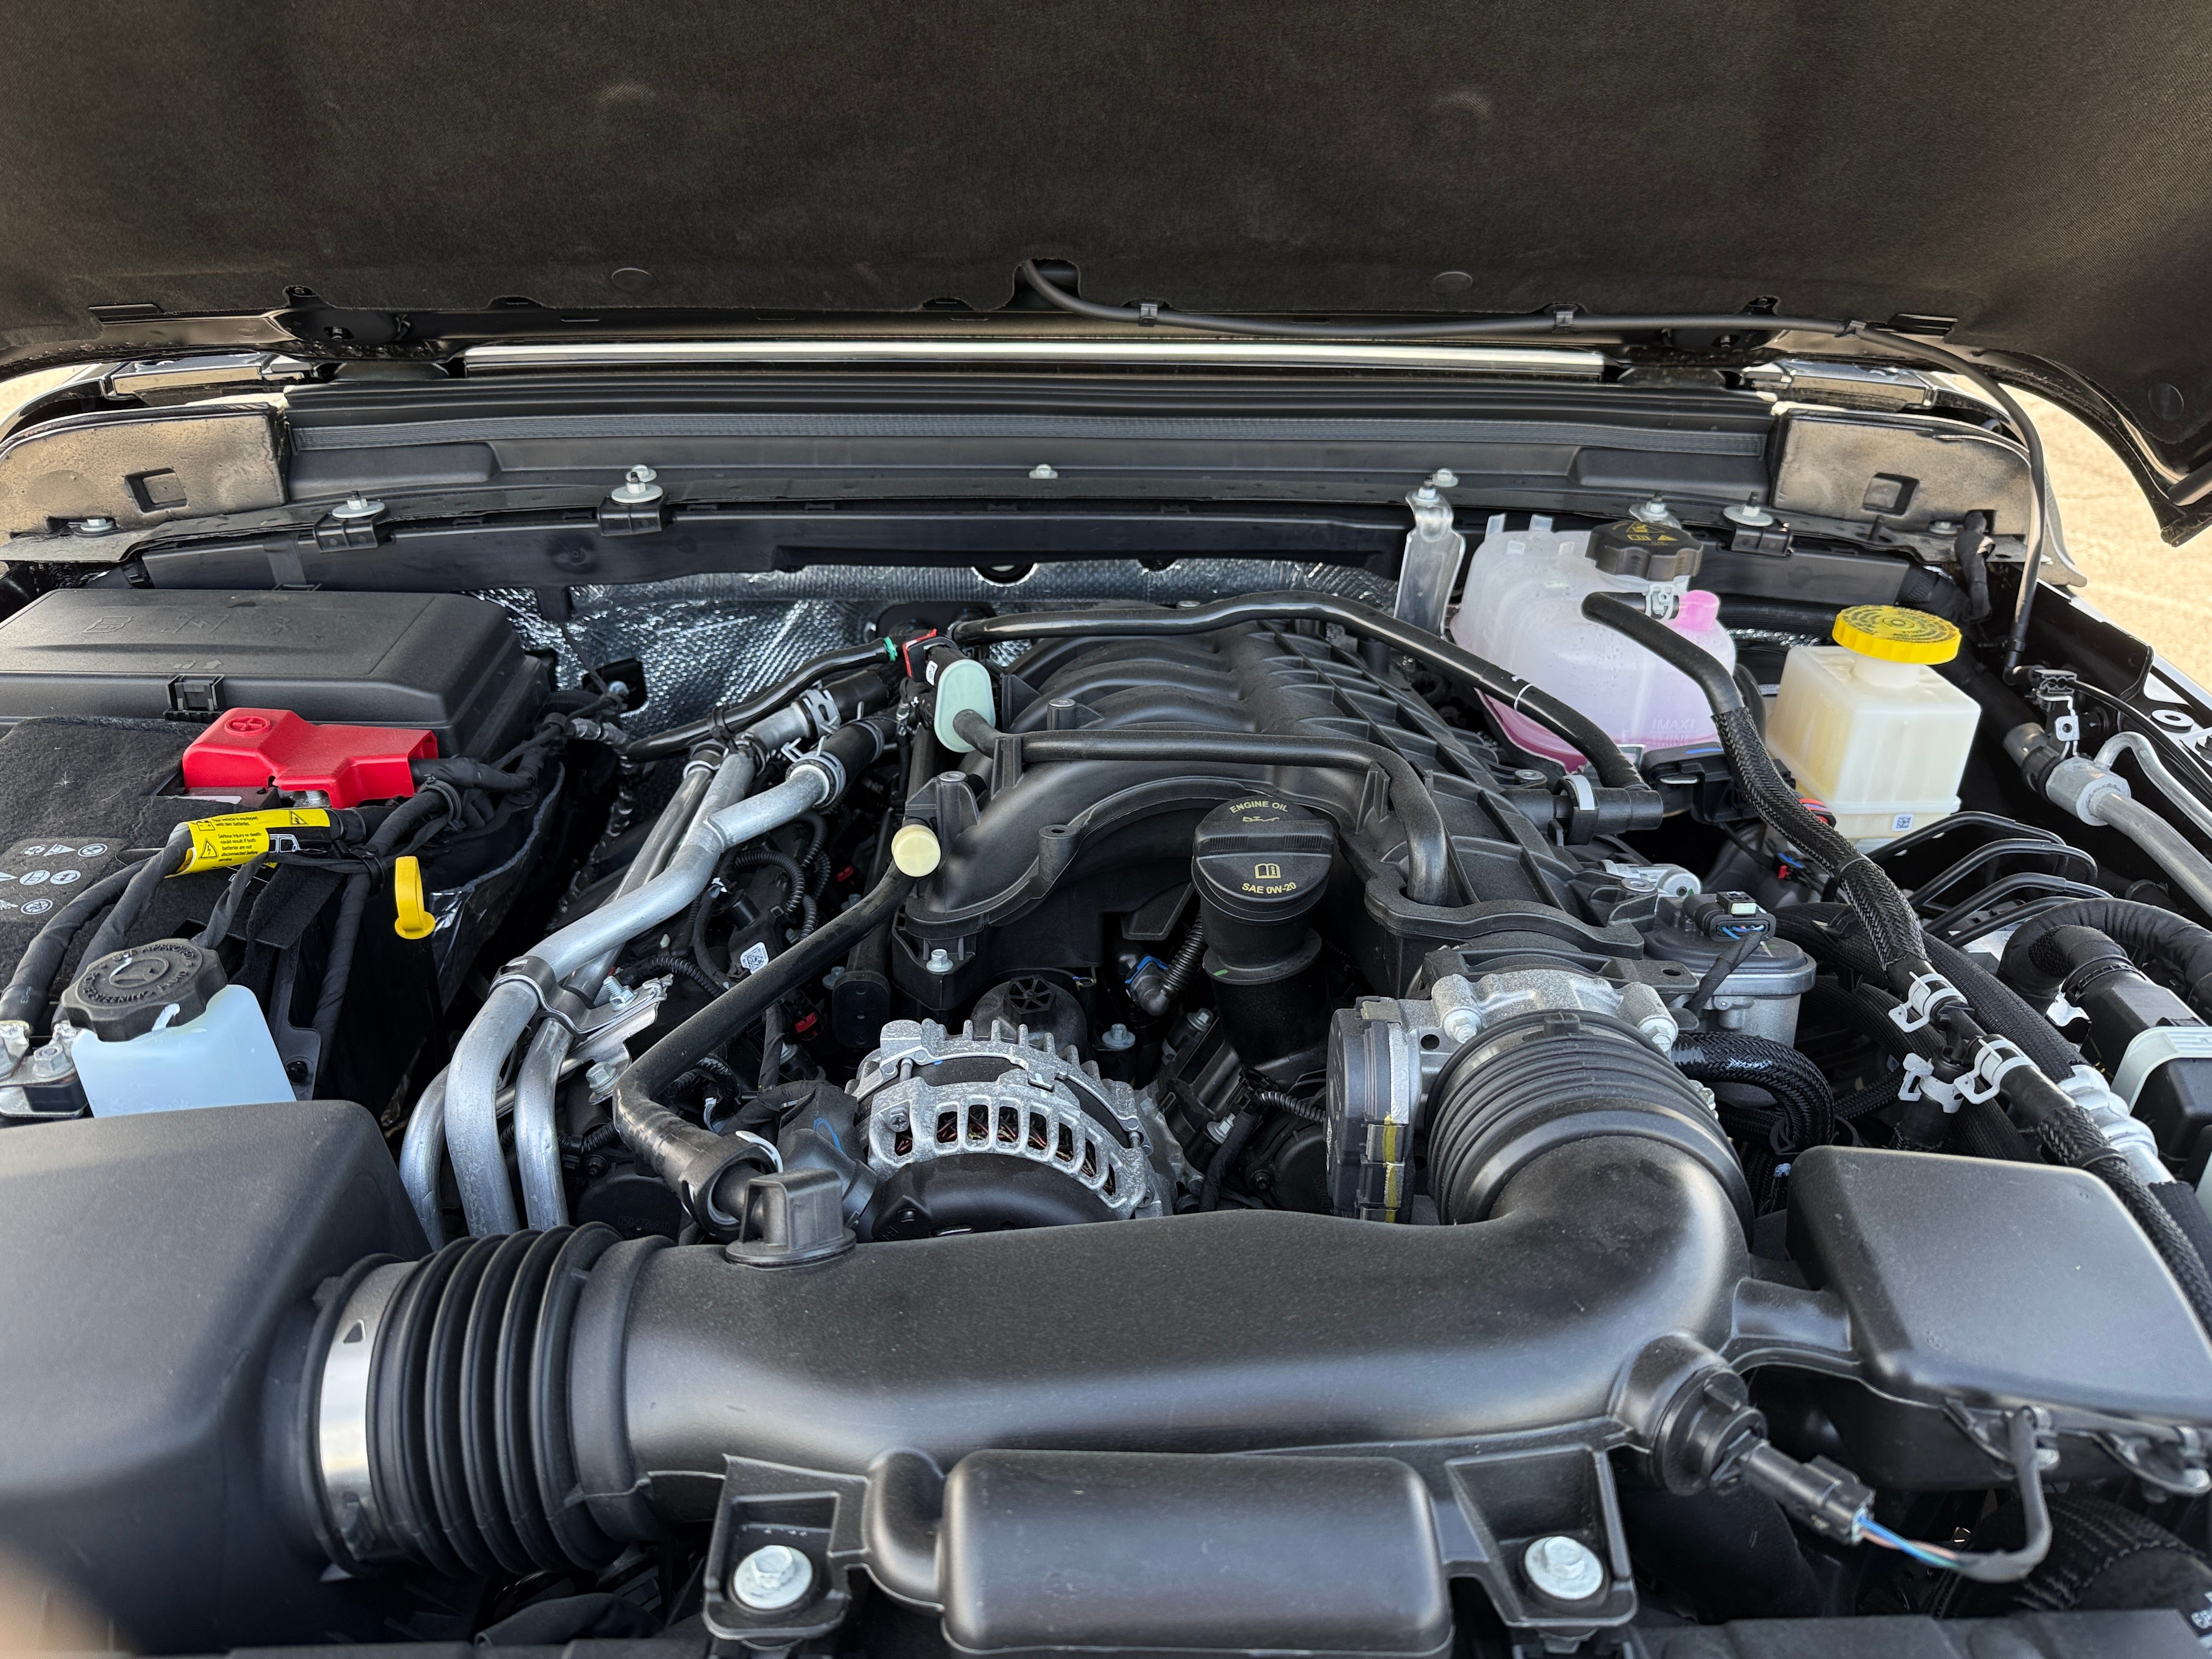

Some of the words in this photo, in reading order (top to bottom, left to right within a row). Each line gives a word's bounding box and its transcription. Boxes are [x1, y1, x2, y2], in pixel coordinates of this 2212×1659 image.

[1229, 800, 1269, 813] ENGINE
[1272, 802, 1288, 812] OIL
[1242, 883, 1264, 894] SAE
[1266, 882, 1297, 894] 0W-20
[142, 944, 194, 958] APPROVED
